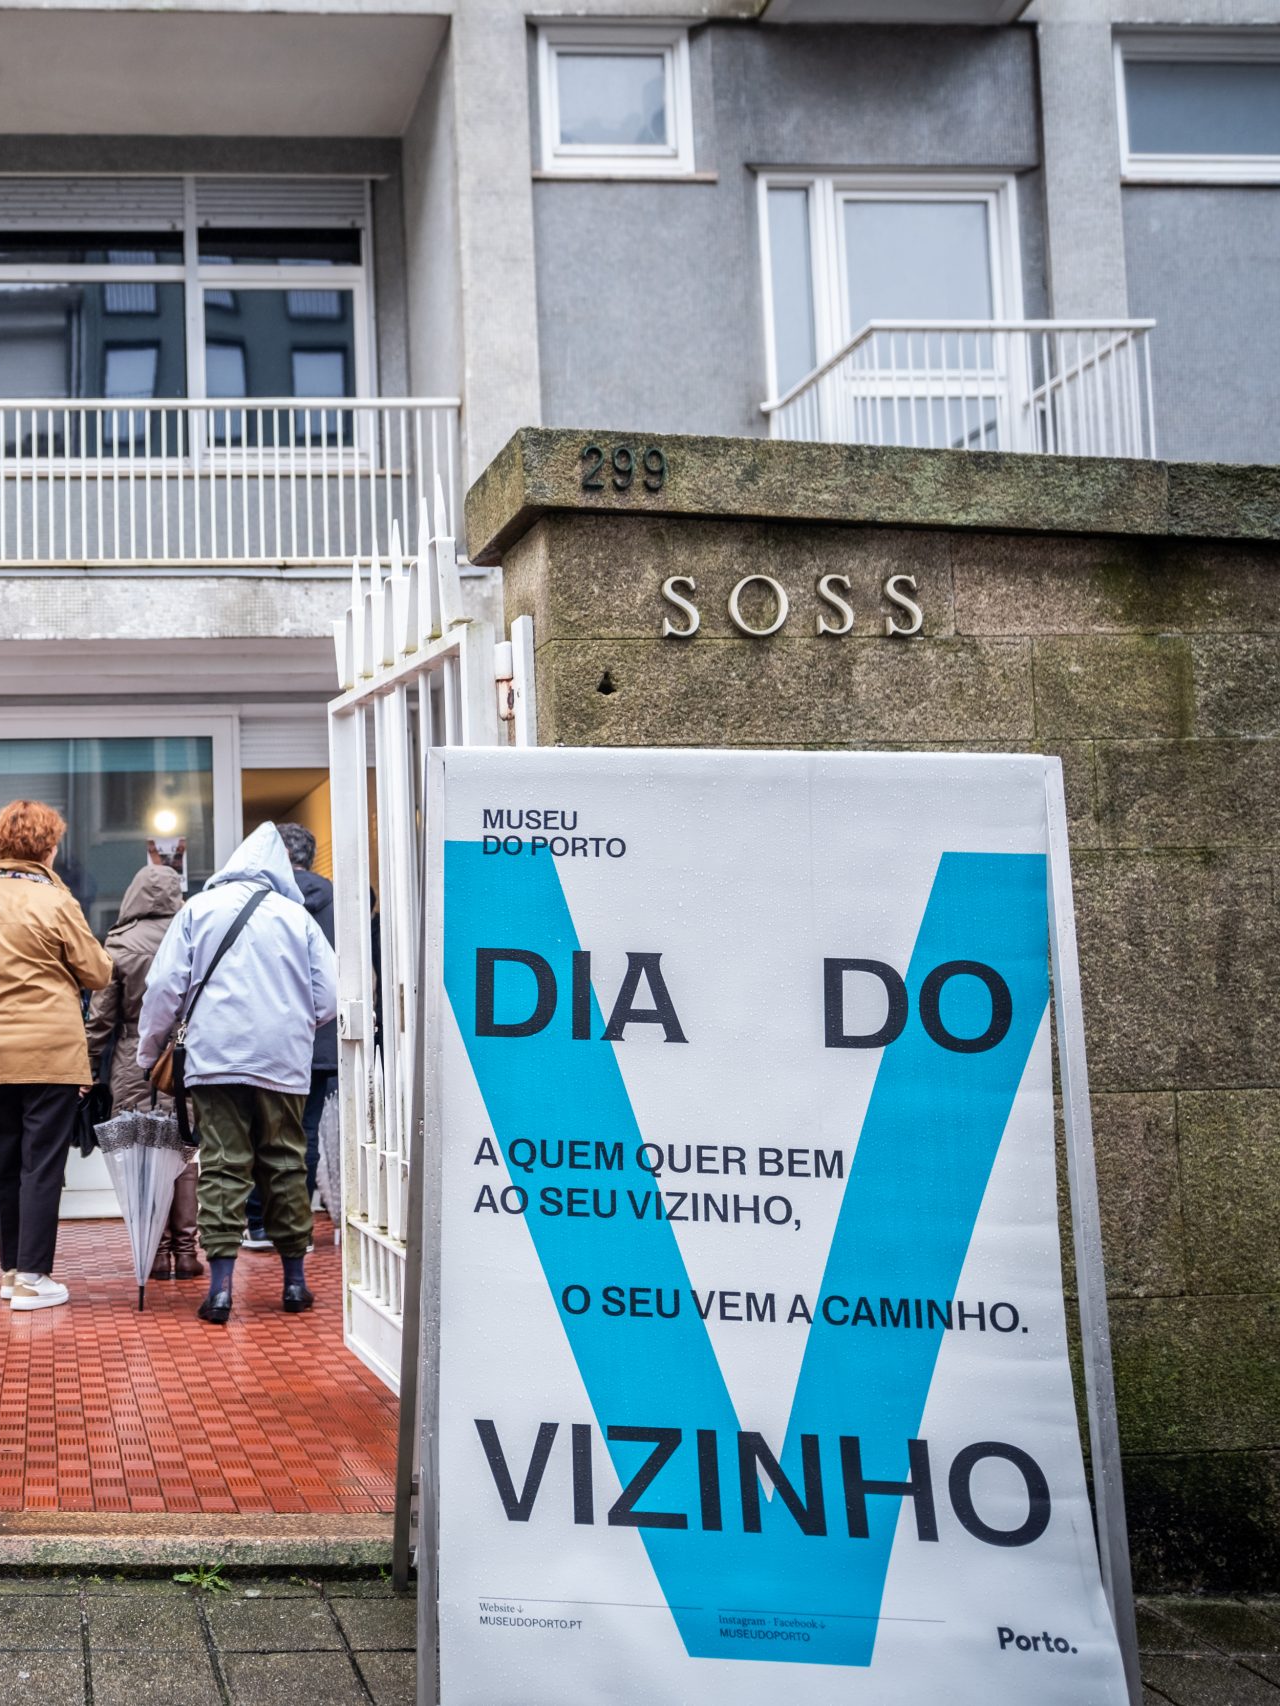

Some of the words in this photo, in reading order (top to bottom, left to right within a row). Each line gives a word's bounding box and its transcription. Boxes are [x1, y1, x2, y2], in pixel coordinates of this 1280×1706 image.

[581, 444, 668, 492] 299
[661, 574, 924, 639] SOSS
[482, 808, 578, 831] MUSEU
[482, 835, 524, 856] DO
[531, 836, 627, 859] PORTO
[474, 947, 690, 1045] DIA
[823, 957, 1014, 1055] DO
[473, 1137, 500, 1167] A
[508, 1138, 625, 1174] QUEM
[634, 1142, 748, 1178] QUER
[757, 1147, 845, 1179] BEM
[473, 1184, 529, 1216] AO
[538, 1186, 618, 1219] SEU
[626, 1190, 802, 1232] VIZINHO,
[561, 1283, 592, 1316] O
[601, 1285, 681, 1319] SEU
[689, 1290, 777, 1323] VEM
[786, 1294, 814, 1325] A
[821, 1295, 1030, 1334] CAMINHO.
[473, 1419, 1053, 1548] VIZINHO
[478, 1602, 516, 1614] Website
[478, 1615, 583, 1631] MUSEUDOPORTO.PT
[718, 1613, 766, 1629] Instagram
[773, 1616, 819, 1630] Facebook
[719, 1627, 811, 1643] MUSEUDOPORTO
[996, 1626, 1079, 1655] Porto.
